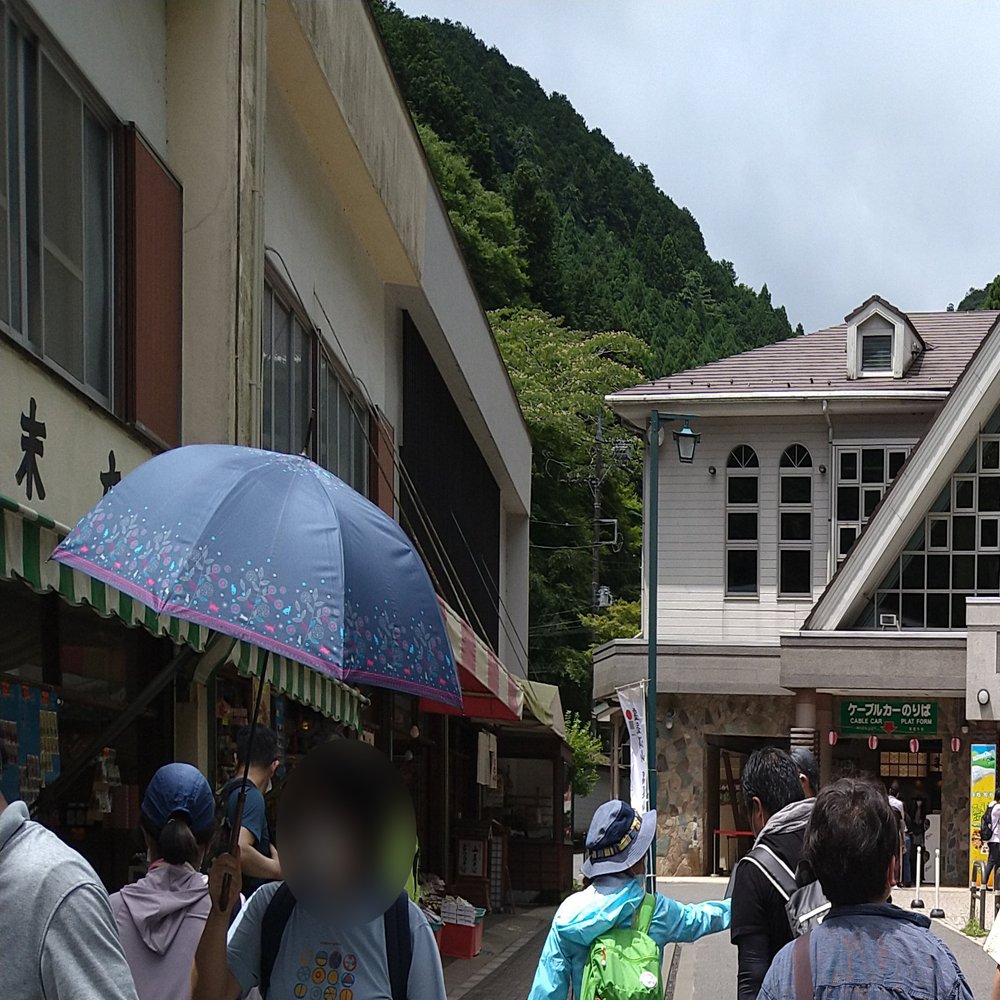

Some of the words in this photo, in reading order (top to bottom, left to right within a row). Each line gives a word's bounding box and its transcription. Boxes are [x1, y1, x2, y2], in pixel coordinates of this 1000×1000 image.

[847, 702, 931, 717] ケーブルカーのりば
